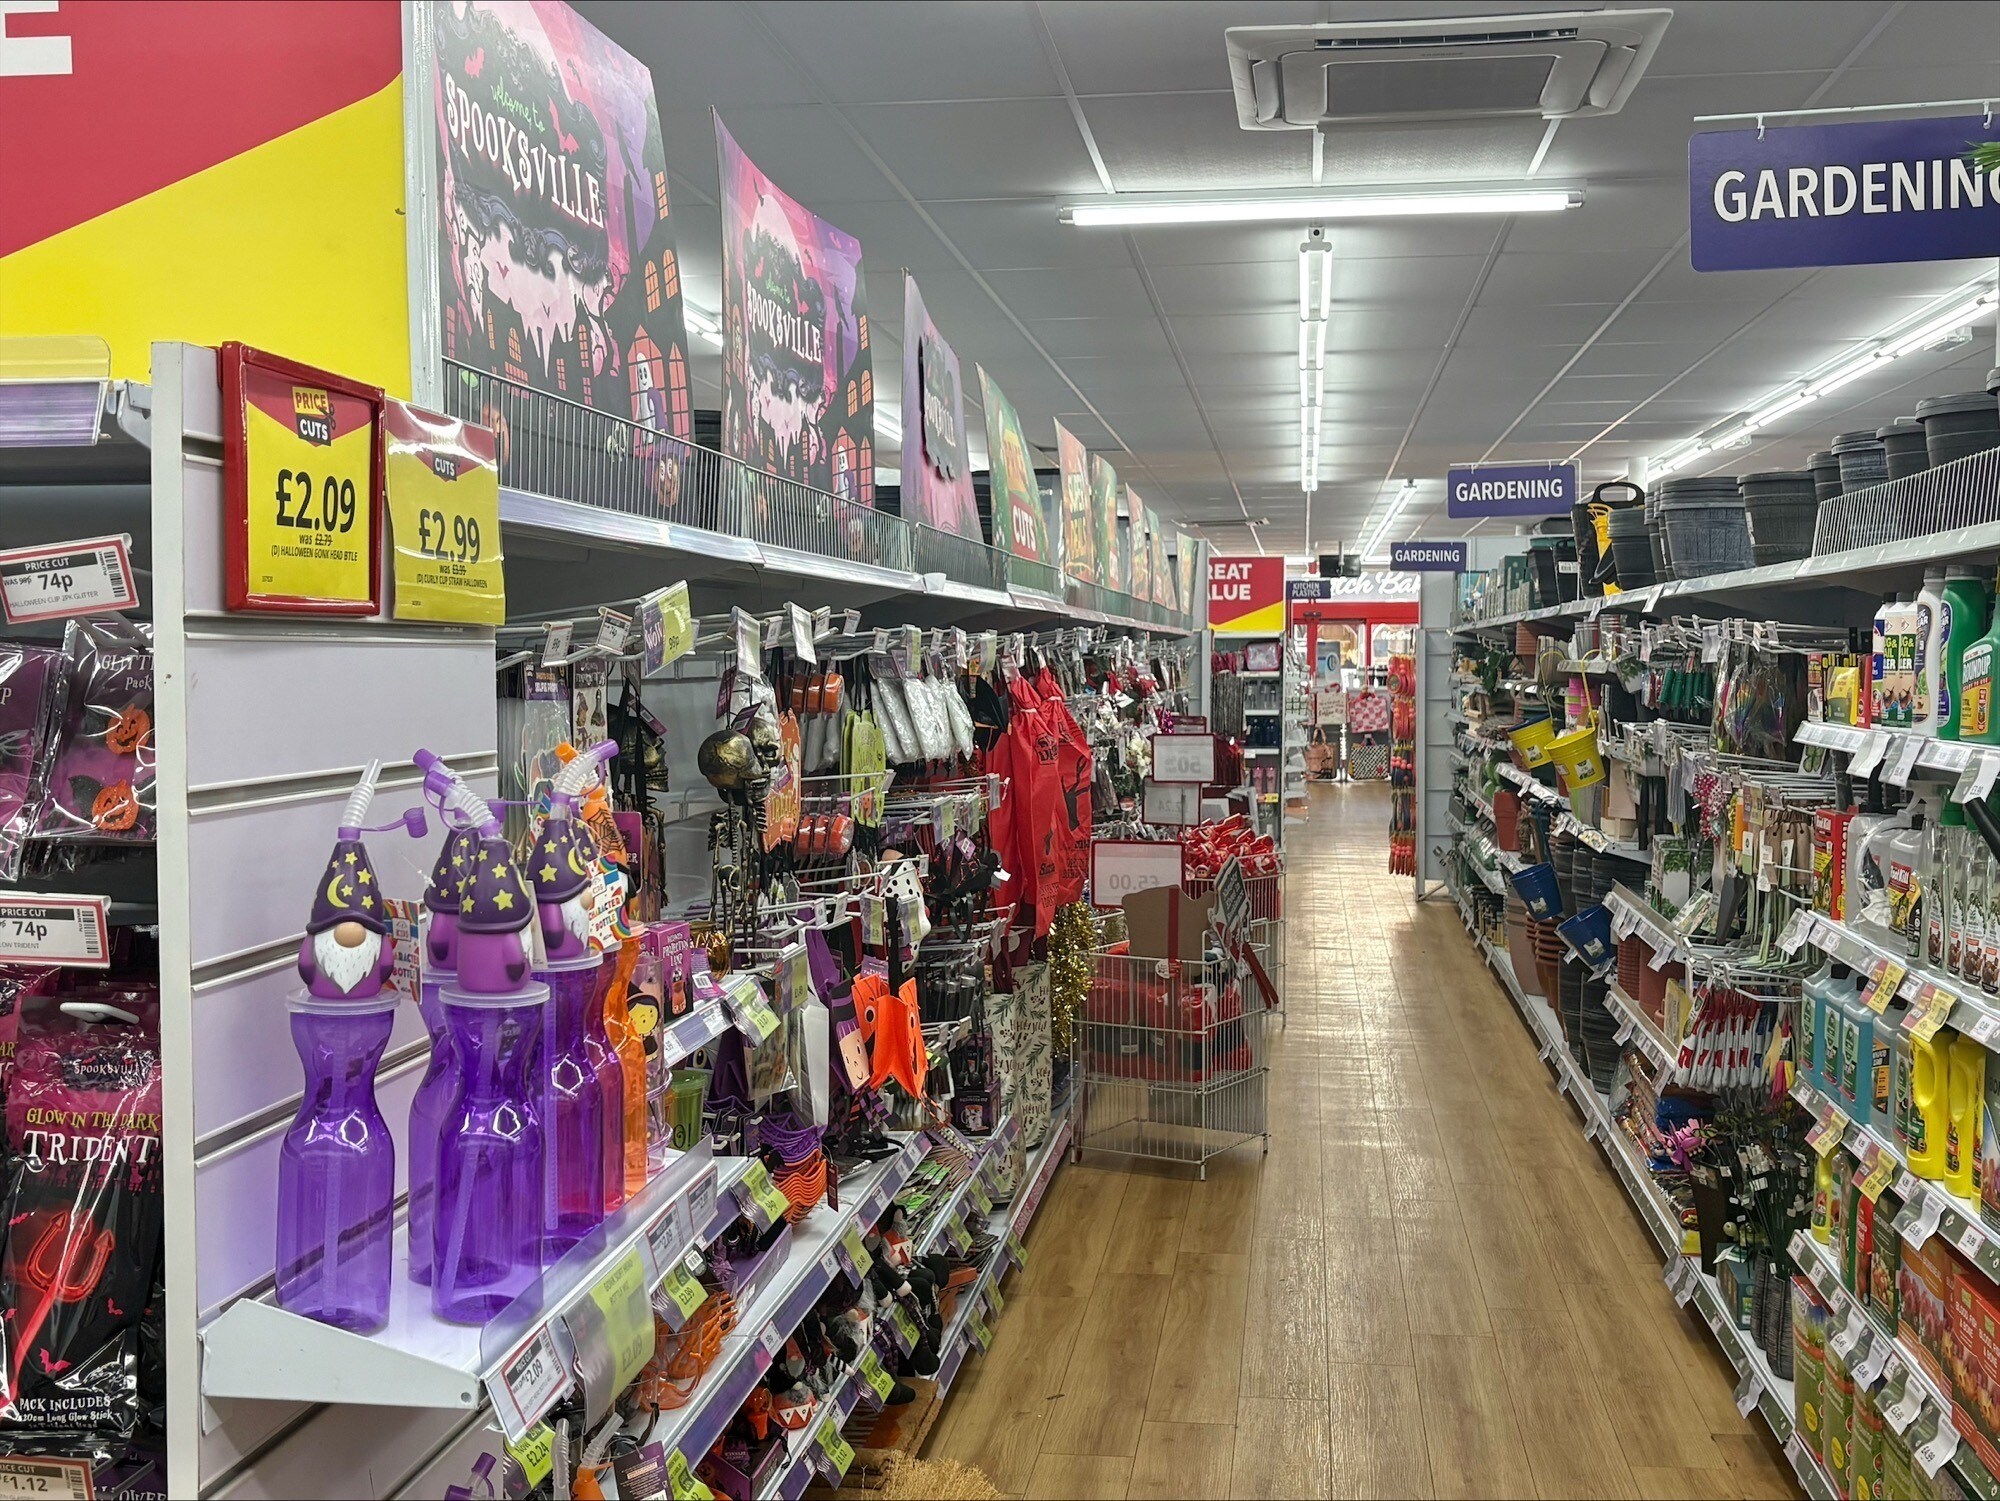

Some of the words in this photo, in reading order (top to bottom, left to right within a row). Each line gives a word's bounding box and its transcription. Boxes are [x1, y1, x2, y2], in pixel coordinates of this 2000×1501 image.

[445, 72, 604, 229] SPOOKSVILLE
[746, 280, 823, 364] SPOOKSVILLE
[295, 391, 327, 411] PRICE
[299, 419, 329, 441] CUTS
[434, 458, 456, 479] CUTS
[1454, 478, 1564, 503] GARDENING
[275, 468, 356, 533] £2.09
[418, 508, 480, 565] £2.99
[1012, 504, 1037, 552] CUTS
[299, 534, 313, 546] was
[280, 547, 314, 559] HALLOWEEN
[1394, 548, 1461, 565] GARDENING
[24, 560, 51, 572] PRICE
[52, 557, 70, 569] CUT
[439, 565, 451, 575] was
[4, 578, 18, 586] WAS
[37, 572, 74, 593] 74p
[463, 577, 488, 589] HALLOWEEN
[1292, 582, 1320, 590] KITCHEN
[10, 597, 47, 609] HALLOWEEN
[47, 595, 61, 605] CLIP
[74, 590, 99, 600] GLITTER
[1207, 583, 1252, 601] LUE
[1291, 589, 1321, 597] PLASTICS
[1, 908, 27, 917] PRICE
[28, 908, 47, 917] CUT
[588, 897, 622, 920] CHARACTER
[12, 920, 48, 941] 74p
[595, 913, 617, 932] BOTTLE
[26, 1107, 70, 1126] GLOW
[70, 1112, 88, 1129] IN
[91, 1111, 118, 1130] THE
[120, 1113, 161, 1132] DARK
[23, 1130, 159, 1166] TRIDENT
[678, 1286, 695, 1306] £2.99
[515, 1357, 527, 1374] PRICE
[525, 1358, 544, 1387] £2.09
[19, 1397, 47, 1412] PACK
[50, 1395, 111, 1411] INCLUDES
[47, 1412, 66, 1424] Long
[68, 1411, 89, 1423] Glow
[89, 1410, 114, 1421] Stick
[526, 1441, 550, 1467] £2.24
[17, 1465, 36, 1474] CUT
[3, 1475, 48, 1493] £1.12
